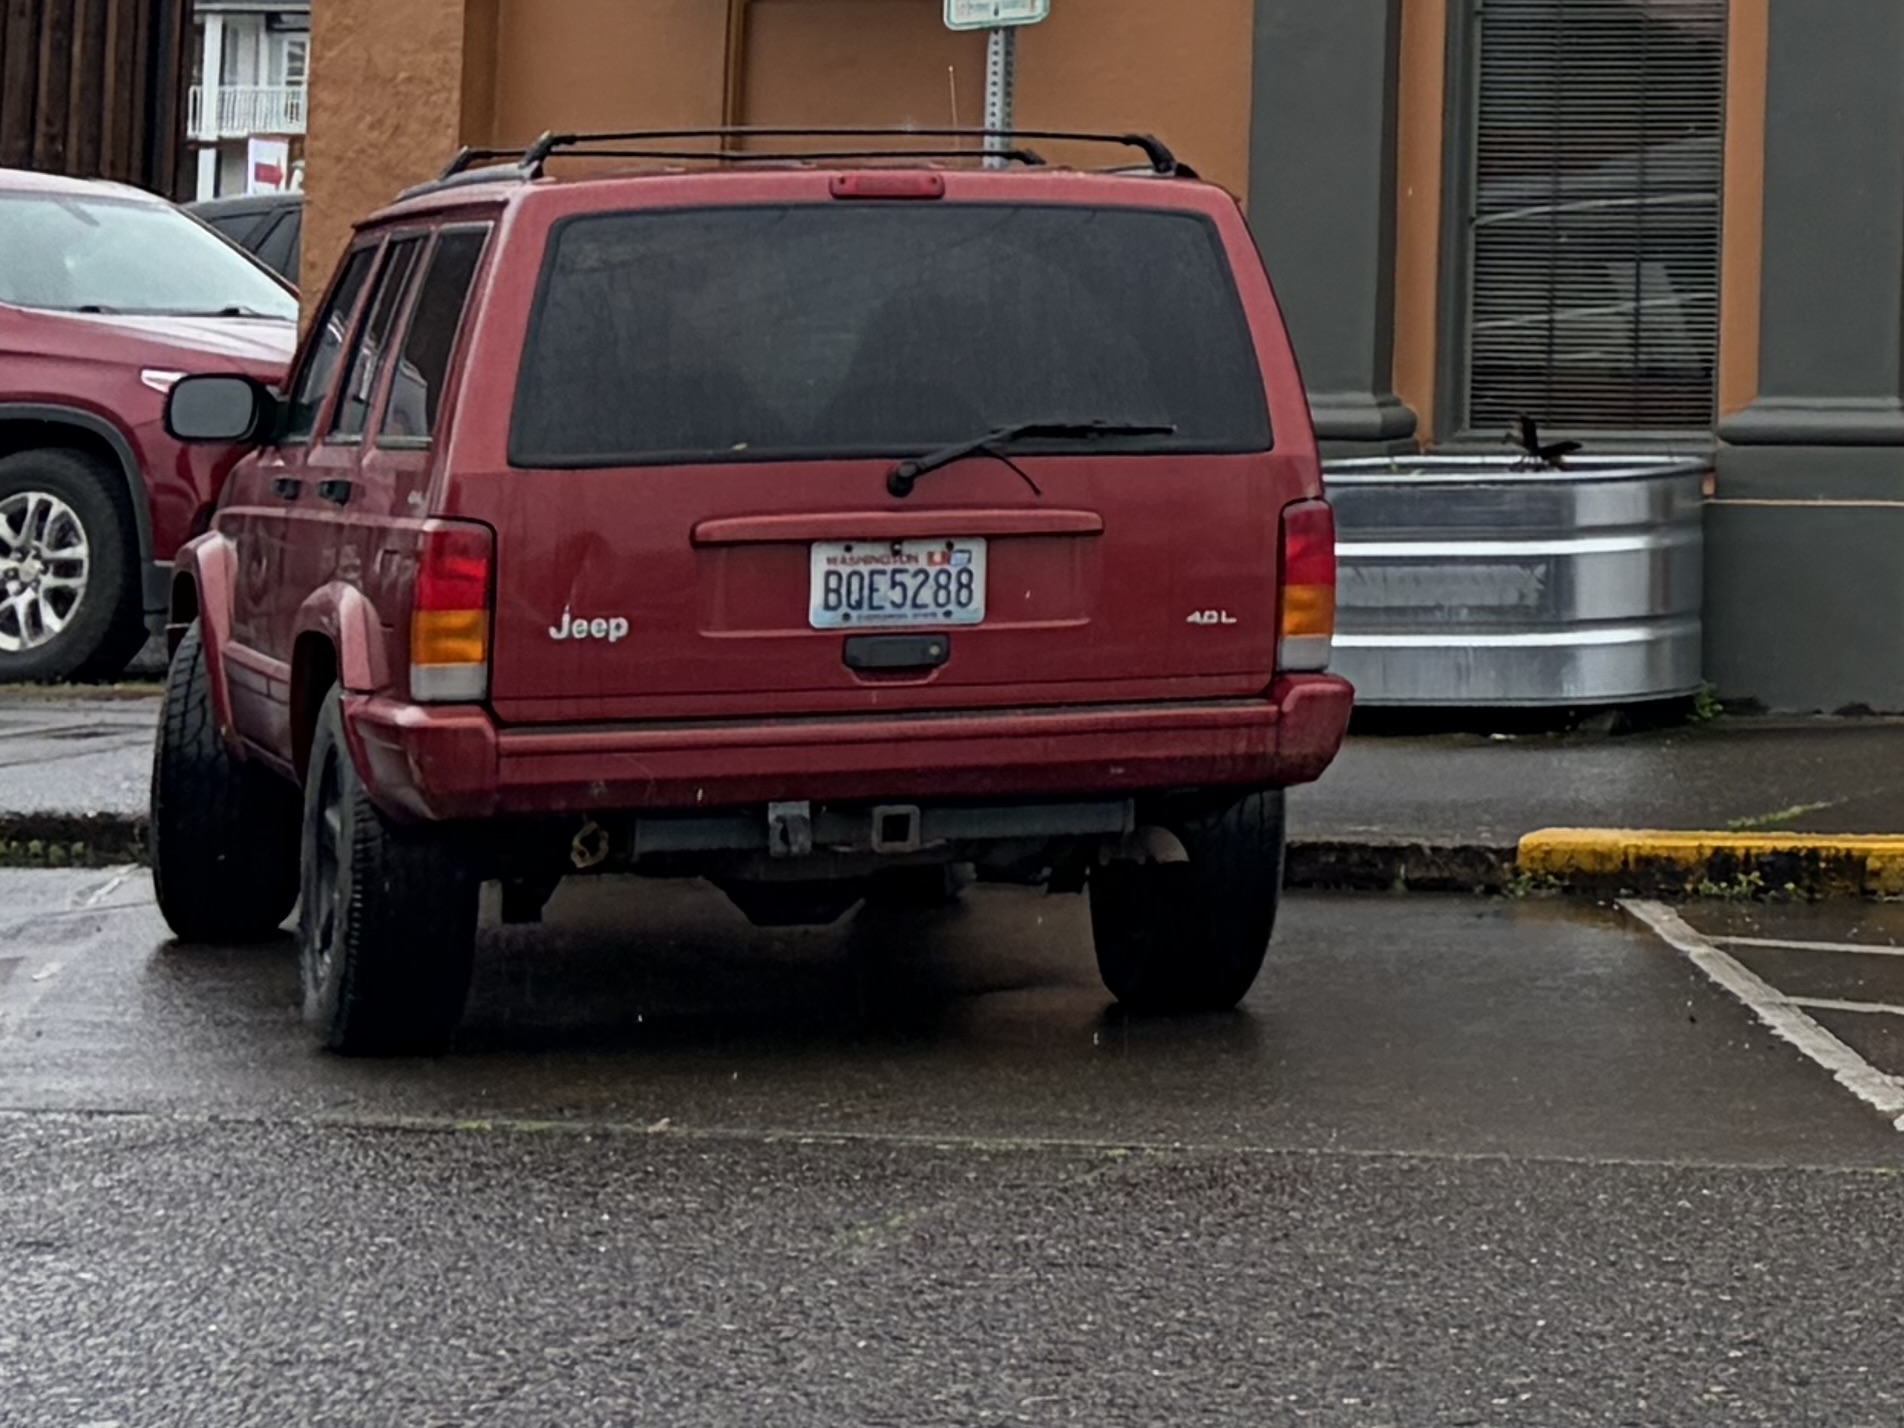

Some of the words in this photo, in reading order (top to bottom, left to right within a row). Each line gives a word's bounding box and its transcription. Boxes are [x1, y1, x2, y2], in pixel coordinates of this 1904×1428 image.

[825, 551, 920, 566] WASHINGTON
[822, 567, 974, 612] BQE5288
[548, 611, 629, 643] Jeep
